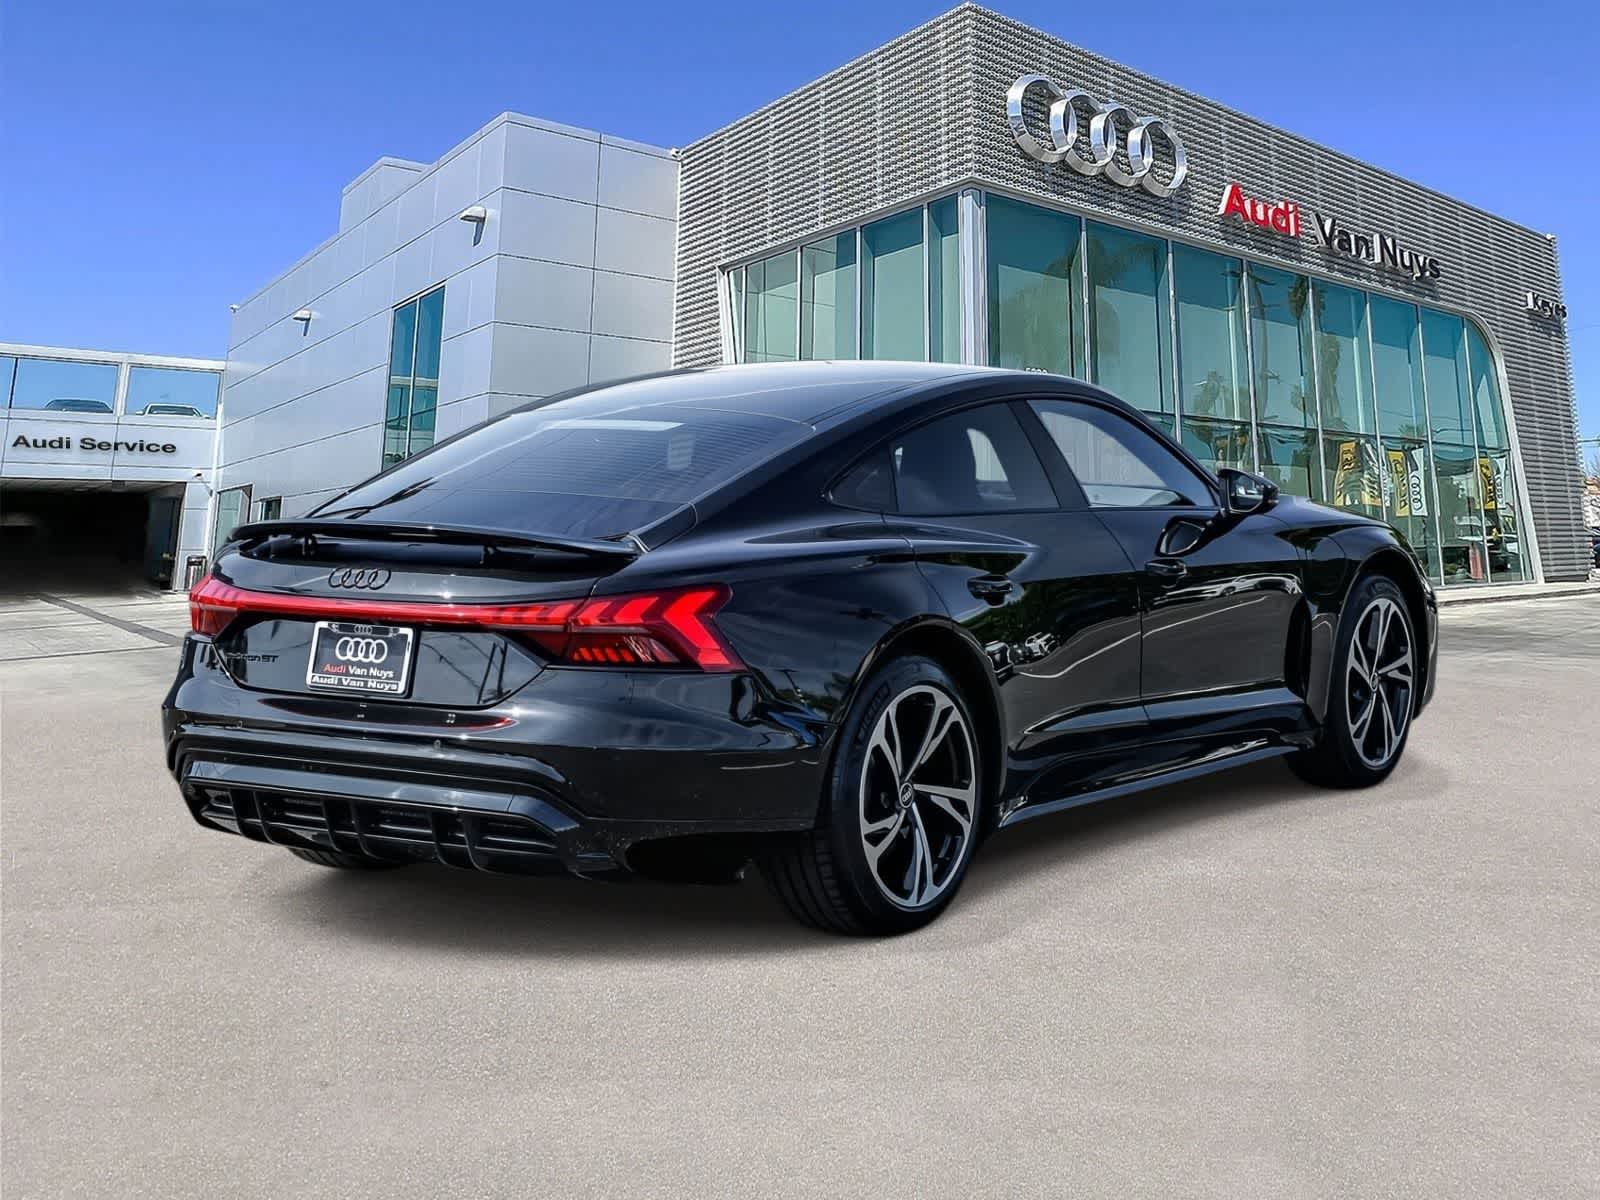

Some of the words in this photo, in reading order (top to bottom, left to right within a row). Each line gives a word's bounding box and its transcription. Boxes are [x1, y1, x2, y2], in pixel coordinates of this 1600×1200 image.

[1219, 183, 1301, 237] Audi
[1312, 212, 1370, 258] Van
[1373, 233, 1441, 281] Nuys
[12, 435, 71, 449] Audi
[79, 437, 177, 453] Service
[324, 663, 347, 674] Audi
[348, 665, 368, 676] Van
[369, 667, 395, 680] Nuys
[312, 675, 339, 685] Audi
[342, 678, 364, 687] Van
[367, 681, 398, 691] Nuys
